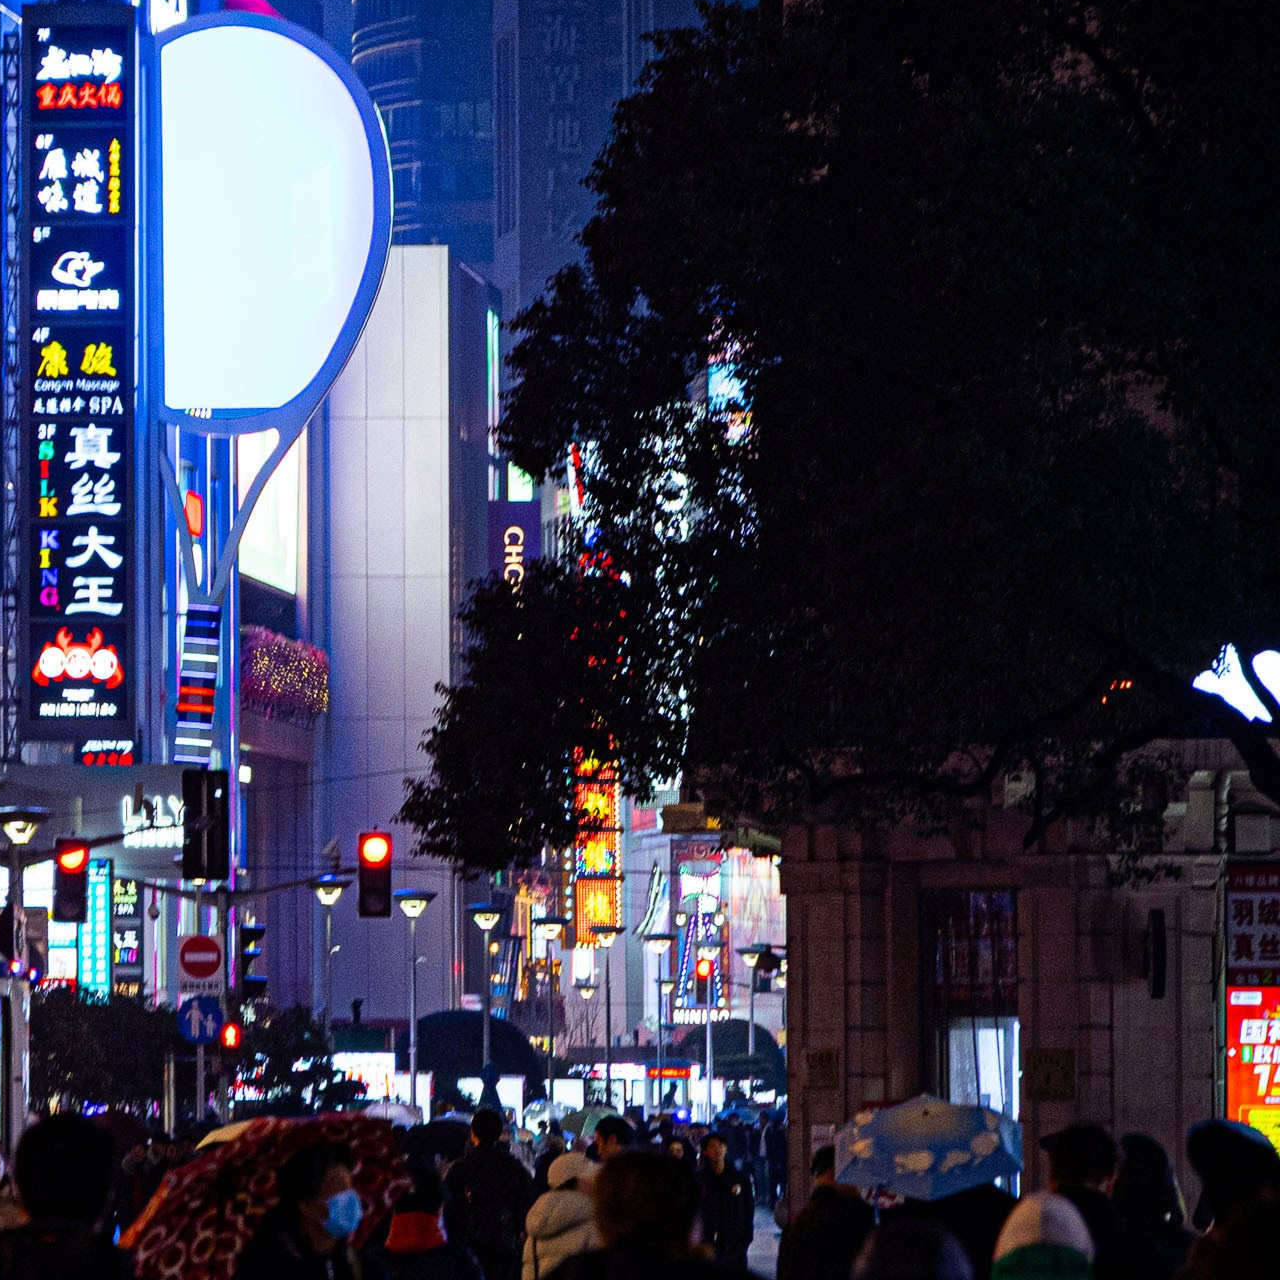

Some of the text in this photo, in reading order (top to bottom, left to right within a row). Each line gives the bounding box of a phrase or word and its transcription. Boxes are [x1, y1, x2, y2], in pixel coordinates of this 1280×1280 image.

[36, 82, 123, 110] 重庆火锅
[32, 326, 51, 343] 4F
[76, 378, 121, 394] Massage
[88, 395, 124, 416] SPA
[37, 423, 57, 440] 3F
[38, 439, 59, 518] SILK
[64, 422, 124, 617] 真丝大王
[122, 794, 185, 828] LLY
